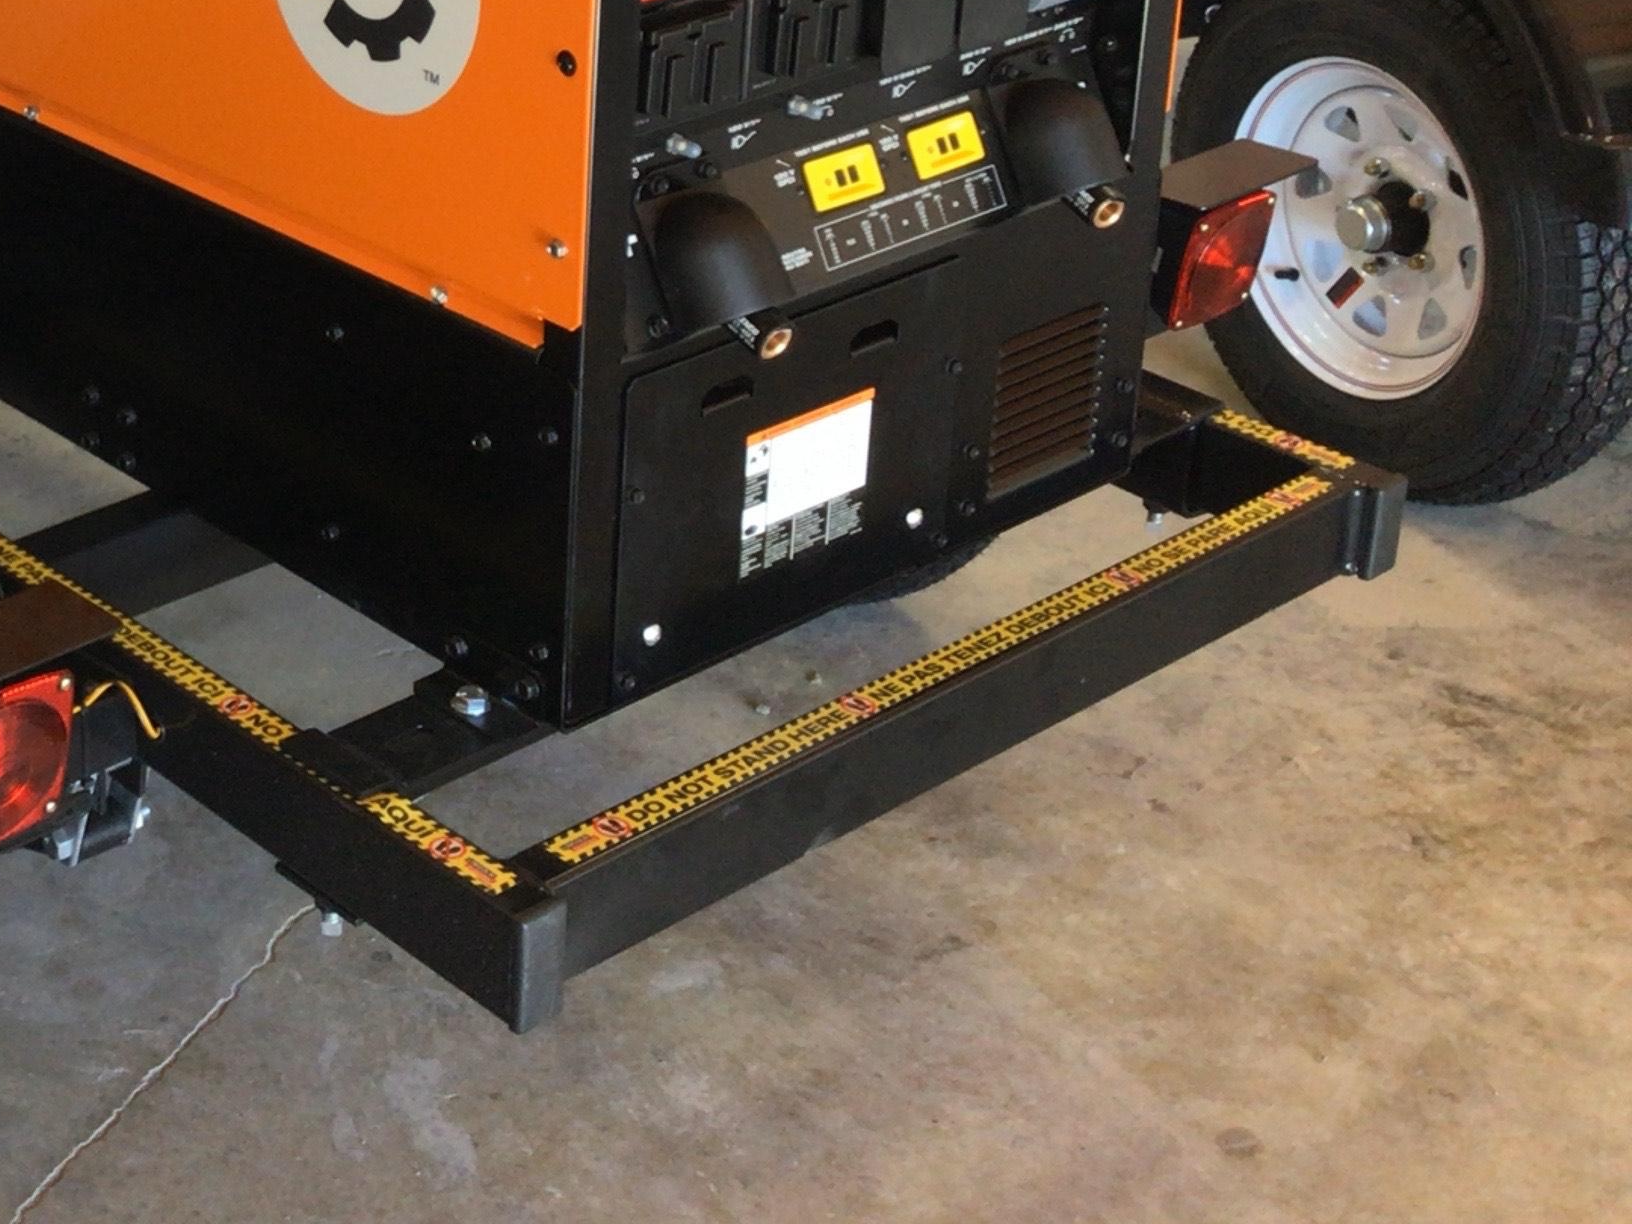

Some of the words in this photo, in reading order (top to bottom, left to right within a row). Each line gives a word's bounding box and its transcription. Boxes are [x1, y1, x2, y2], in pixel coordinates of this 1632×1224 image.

[118, 625, 196, 677] DEBOUT
[244, 713, 284, 738] NO
[626, 801, 665, 823] DO
[663, 775, 716, 810] NOT
[714, 739, 792, 780] STAND
[790, 709, 850, 743] HERE
[869, 682, 901, 702] NE
[901, 661, 946, 688] PAS
[940, 632, 1011, 665] TENEZ
[1006, 593, 1088, 636] DEBOUT
[1084, 581, 1116, 598] ICI
[1132, 557, 1165, 574] NO
[1161, 543, 1188, 561] SE
[1187, 523, 1237, 548] PARE
